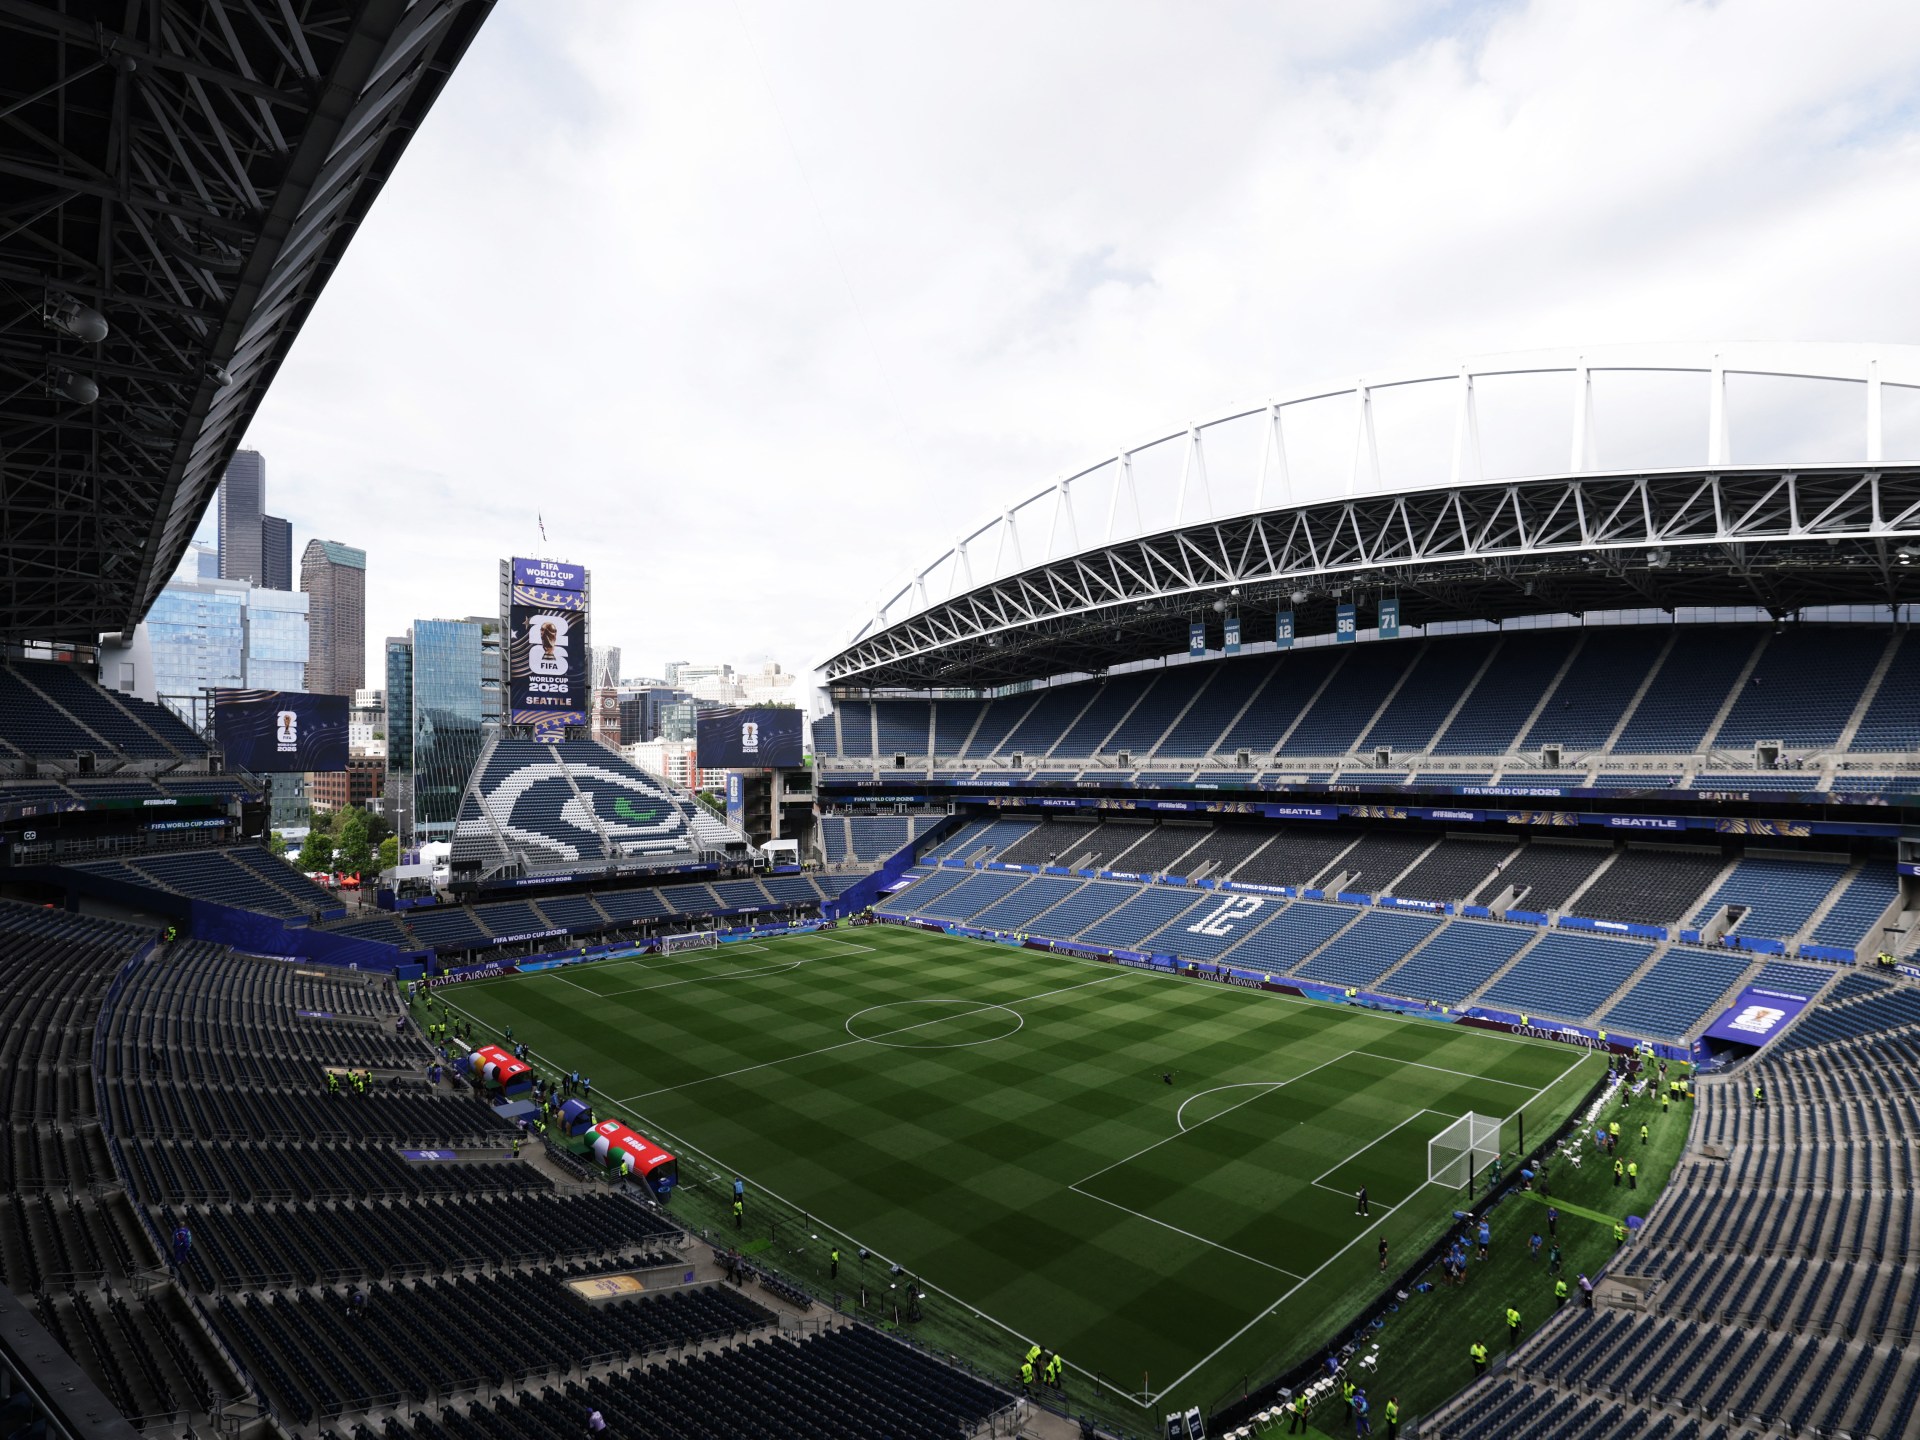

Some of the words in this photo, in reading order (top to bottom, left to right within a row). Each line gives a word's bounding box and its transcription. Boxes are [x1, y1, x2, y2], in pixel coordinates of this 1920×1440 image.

[541, 562, 559, 570] FIFA
[526, 568, 556, 578] WORLD
[535, 577, 564, 586] 2026
[1338, 619, 1353, 632] 96
[1382, 614, 1396, 628] 71
[1279, 625, 1291, 638] 12
[1191, 636, 1203, 648] 45
[1226, 632, 1239, 645] 80
[529, 683, 568, 693] 2026
[526, 696, 572, 706] SEATTLE
[1699, 792, 1749, 800] SEATTLE
[1432, 811, 1473, 820] #FIFAWorldCup
[1611, 818, 1677, 828] SEATTLE
[1396, 899, 1436, 908] SEATTLE
[1187, 895, 1264, 936] 12
[1049, 947, 1070, 956] QATAR
[1072, 950, 1098, 960] AIRWAYS
[1156, 964, 1175, 974] AMERICA
[430, 973, 464, 987] QATAR
[465, 969, 503, 980] AIRWAYS
[1198, 972, 1224, 983] QATAR
[1228, 977, 1262, 989] AIRWAYS
[1511, 1025, 1552, 1040] QATAR
[1558, 1033, 1610, 1051] AIRWAYS
